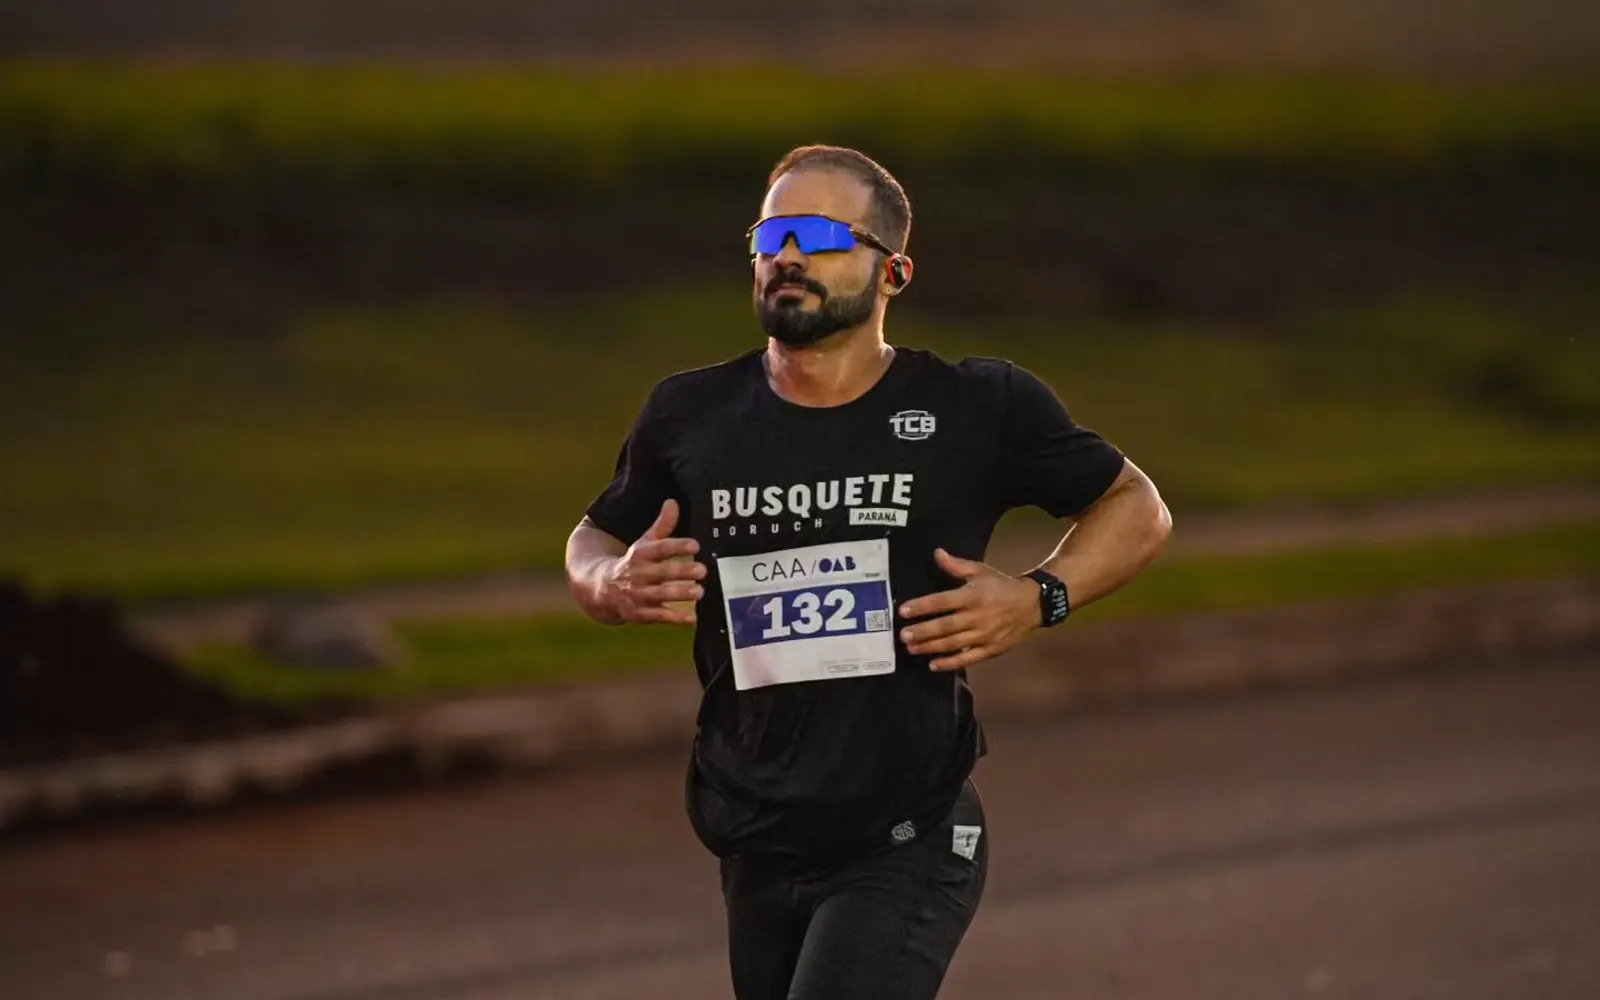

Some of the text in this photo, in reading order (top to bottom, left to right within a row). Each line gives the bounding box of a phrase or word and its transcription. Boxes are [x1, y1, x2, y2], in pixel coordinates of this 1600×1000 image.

[889, 416, 936, 433] TCB
[711, 473, 914, 520] BUSQUETE
[858, 510, 897, 523] PARANÁ
[713, 518, 823, 538] BORUCH
[763, 588, 858, 640] 132
